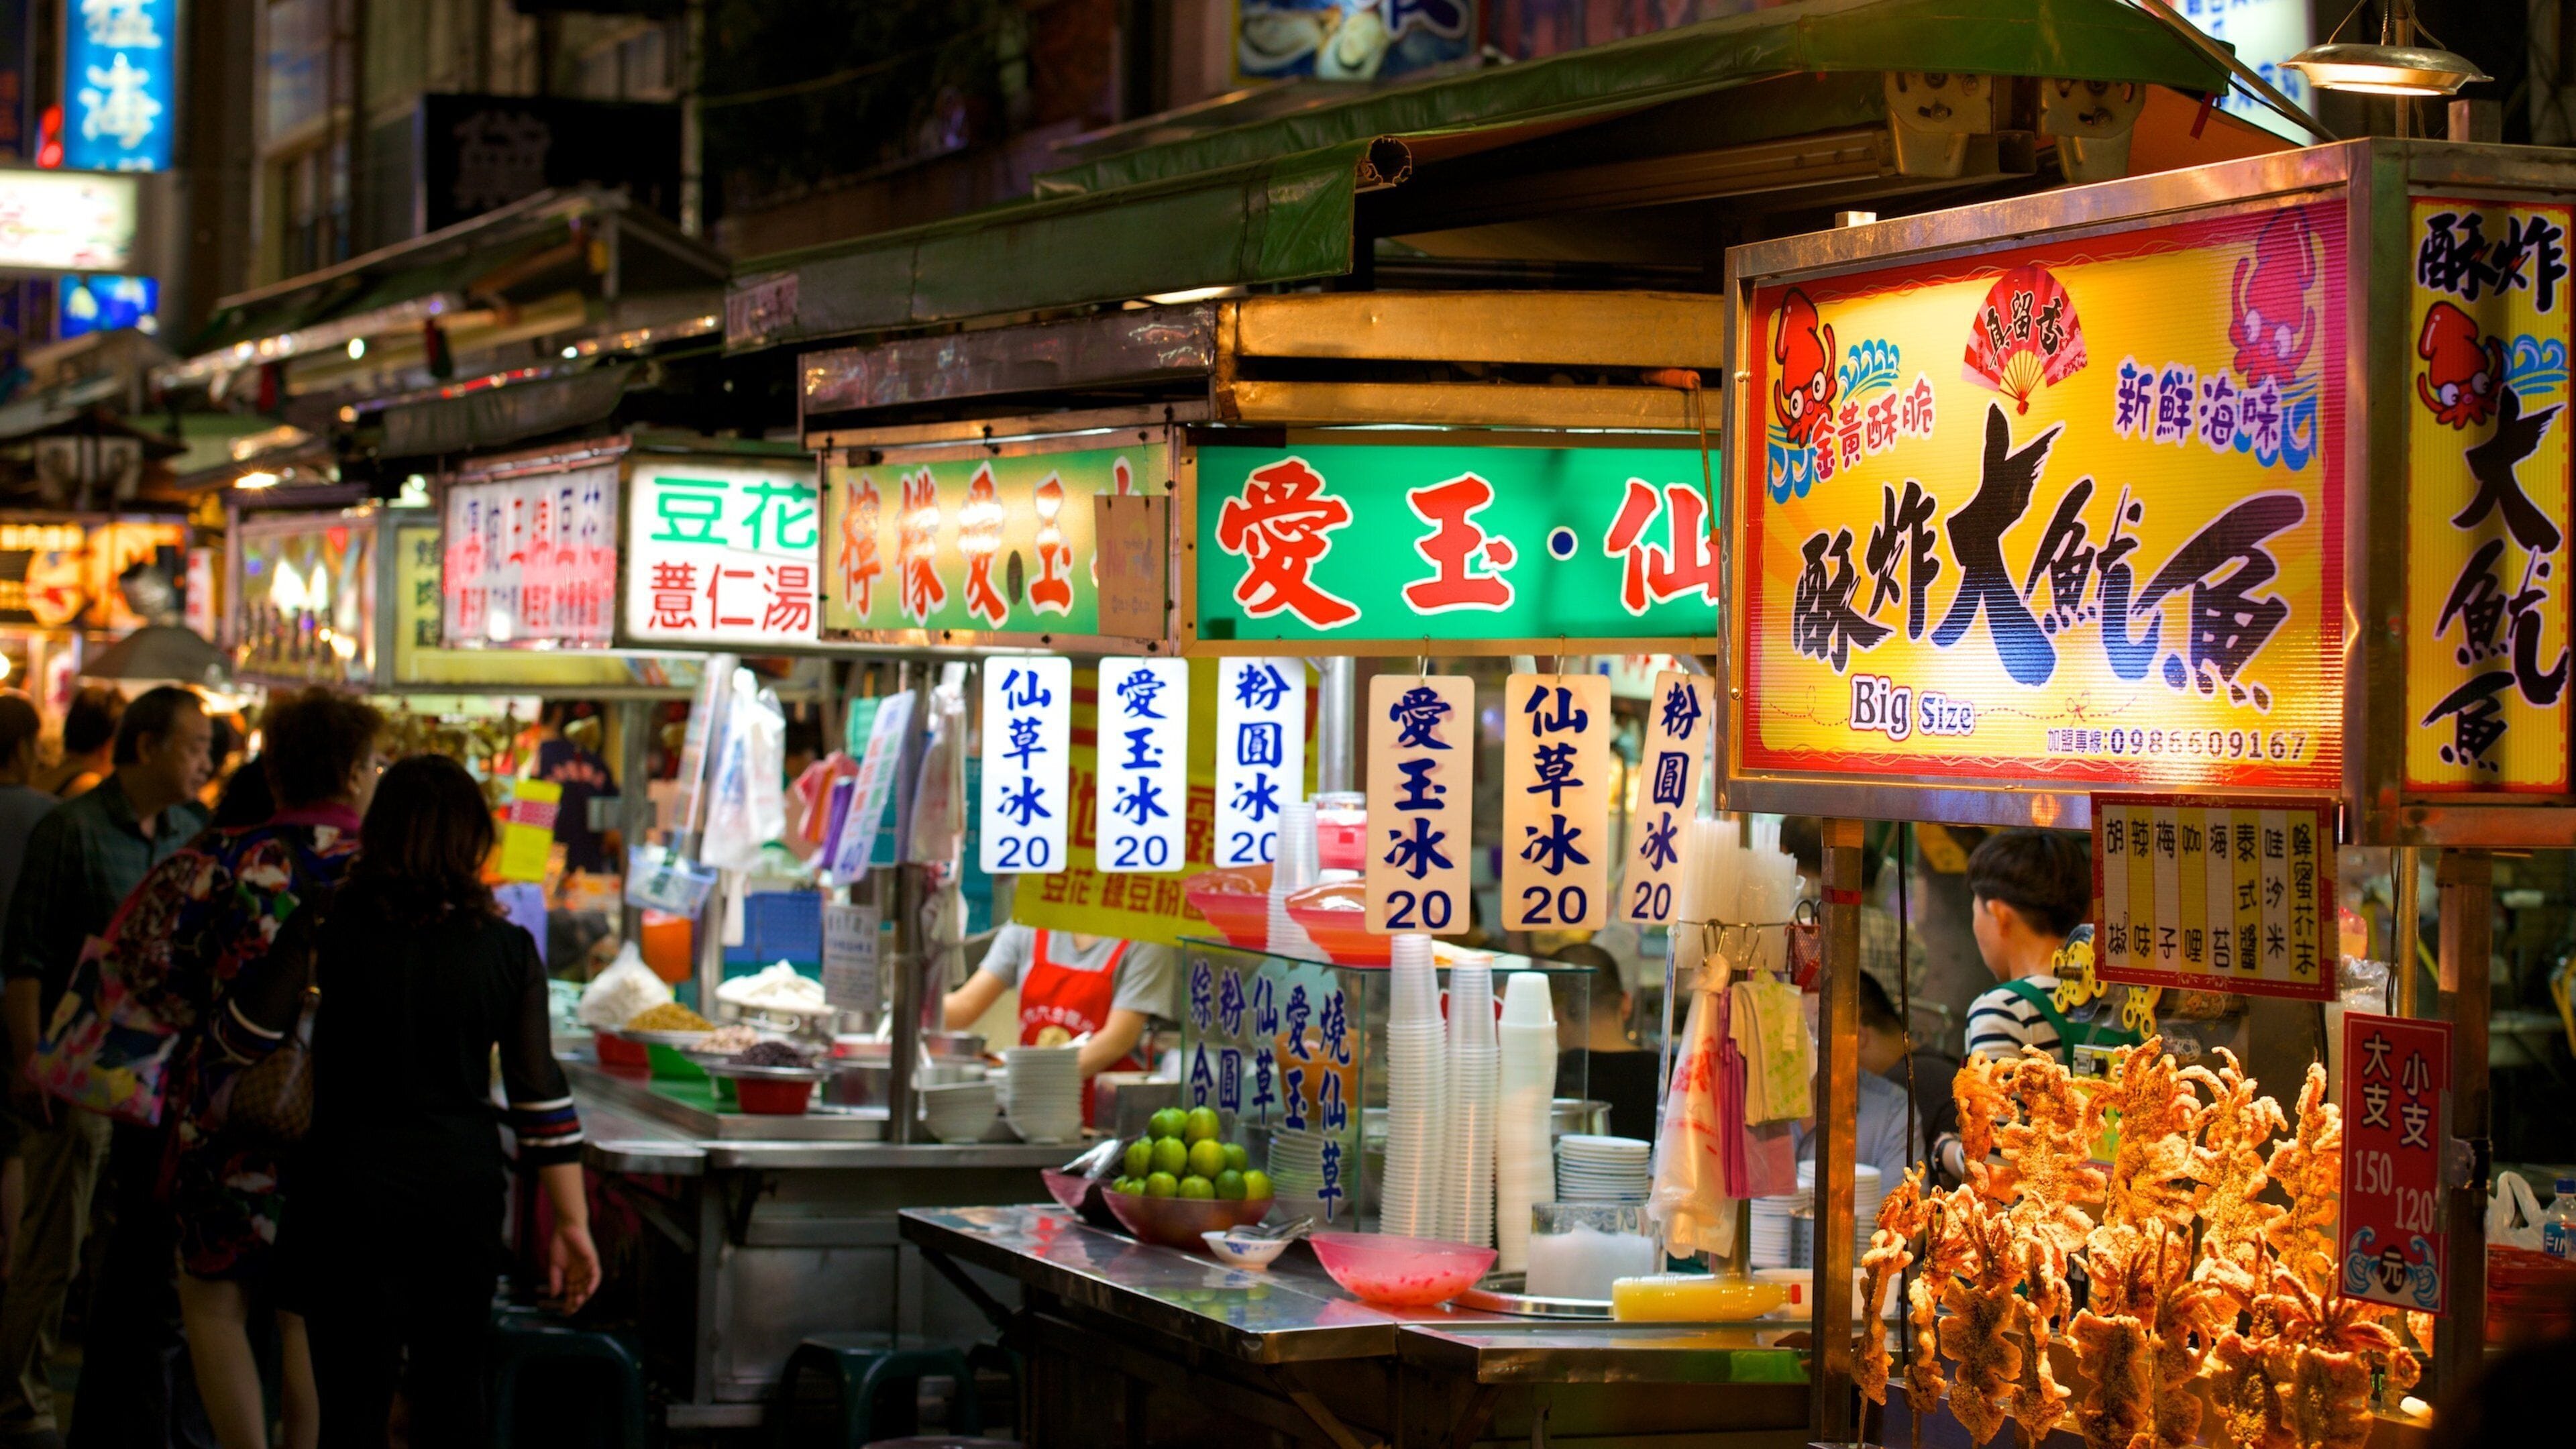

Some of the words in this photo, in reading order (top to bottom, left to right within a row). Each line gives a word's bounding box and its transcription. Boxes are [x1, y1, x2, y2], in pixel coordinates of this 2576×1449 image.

[2419, 213, 2568, 313] 酥炸
[1812, 378, 1933, 480] 金黃酥脆
[2116, 362, 2279, 450] 新鮮海味
[649, 476, 818, 549] 豆花
[837, 458, 1140, 625] 檸檬愛玉
[1793, 404, 2306, 712] 酥炸大魷魚
[649, 561, 812, 632] 薏仁湯
[2422, 385, 2569, 771] 大魷魚
[996, 669, 1052, 827] 仙草冰
[1112, 668, 1170, 826] 愛玉冰
[1230, 665, 1291, 824] 粉圓冰
[1854, 680, 1909, 735] Big
[1921, 696, 1972, 730] Size
[1383, 686, 1454, 881] 愛玉冰
[1520, 684, 1591, 876] 仙草冰
[1640, 681, 1703, 873] 粉圓冰
[996, 836, 1051, 868] 20
[1114, 835, 1169, 867] 20
[1631, 881, 1672, 921] 20
[1385, 890, 1452, 929] 20
[1521, 885, 1588, 925] 20
[1219, 969, 1246, 1114] 粉圓
[1252, 977, 1279, 1125] 仙草
[1285, 985, 1311, 1131] 愛玉
[2362, 1033, 2392, 1128] 大支
[1318, 989, 1350, 1221] 燒仙草
[2400, 1052, 2430, 1149] 小支
[2354, 1148, 2394, 1196] 150
[2394, 1185, 2435, 1234] 120
[2381, 1251, 2404, 1287] 元
